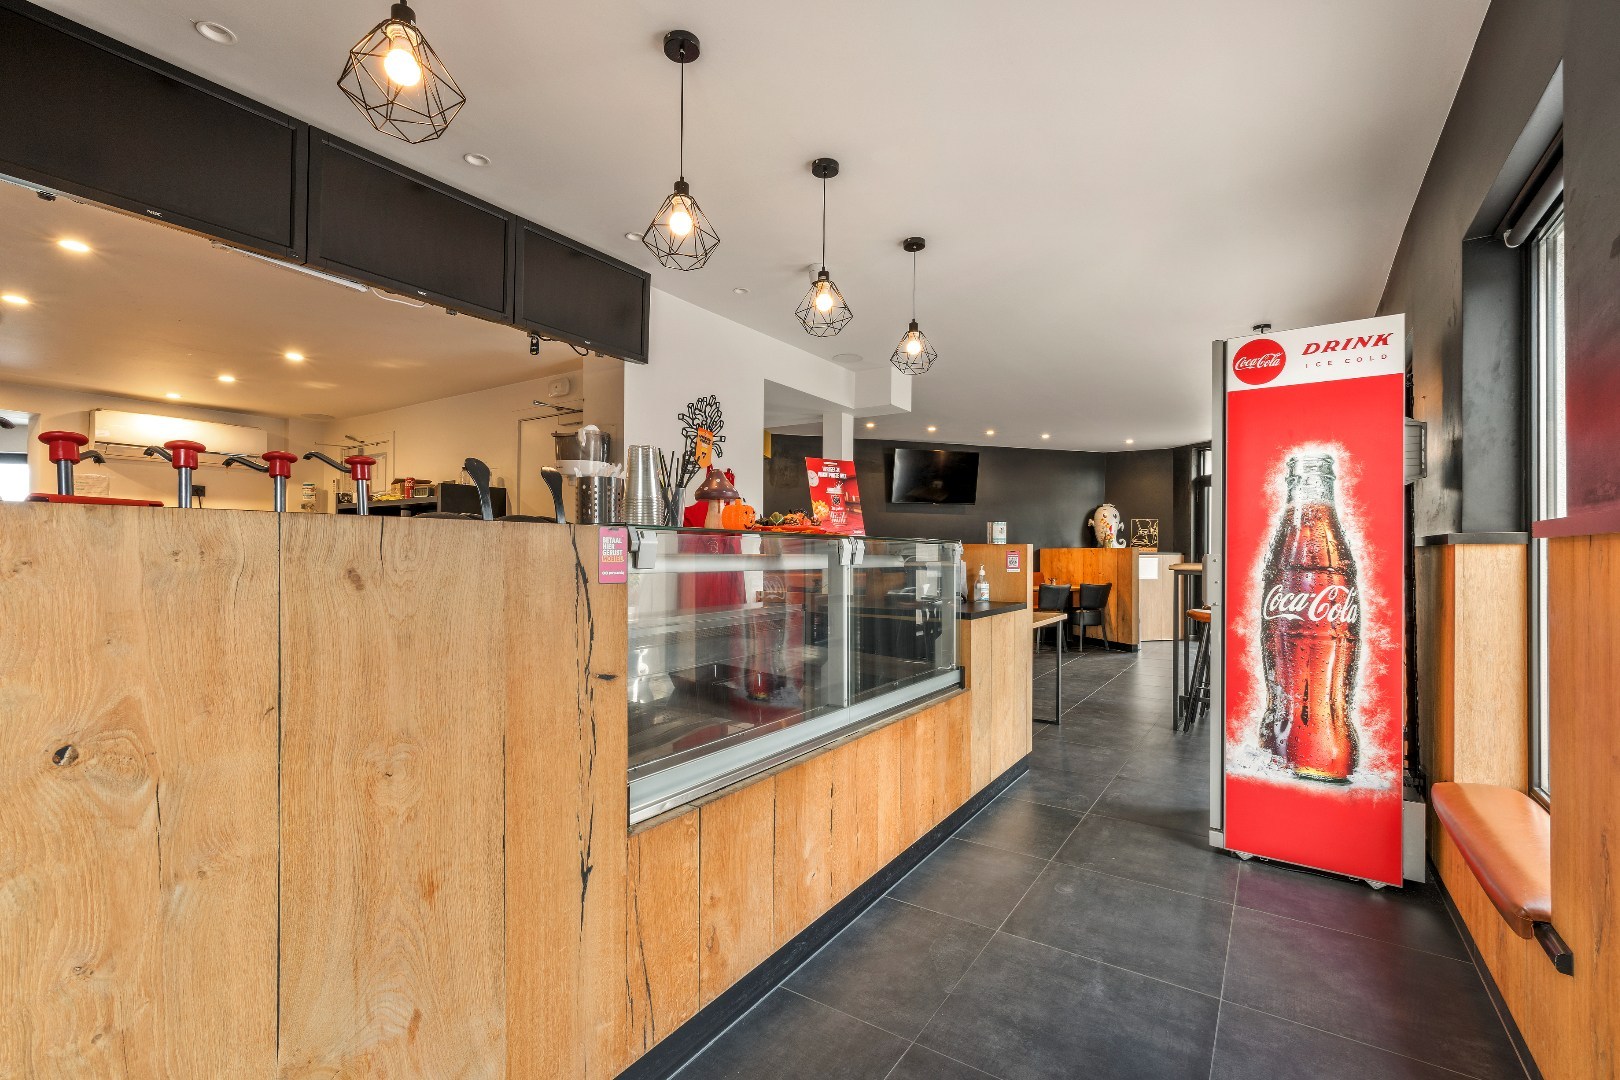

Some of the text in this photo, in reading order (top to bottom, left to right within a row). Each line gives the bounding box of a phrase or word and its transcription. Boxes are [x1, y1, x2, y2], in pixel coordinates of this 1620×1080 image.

[1301, 332, 1394, 356] DRINK
[1234, 352, 1282, 371] Coca-Cola
[1305, 354, 1388, 369] ICE COLD
[602, 536, 622, 544] BETAAL
[1263, 584, 1358, 624] Coca-Cola
